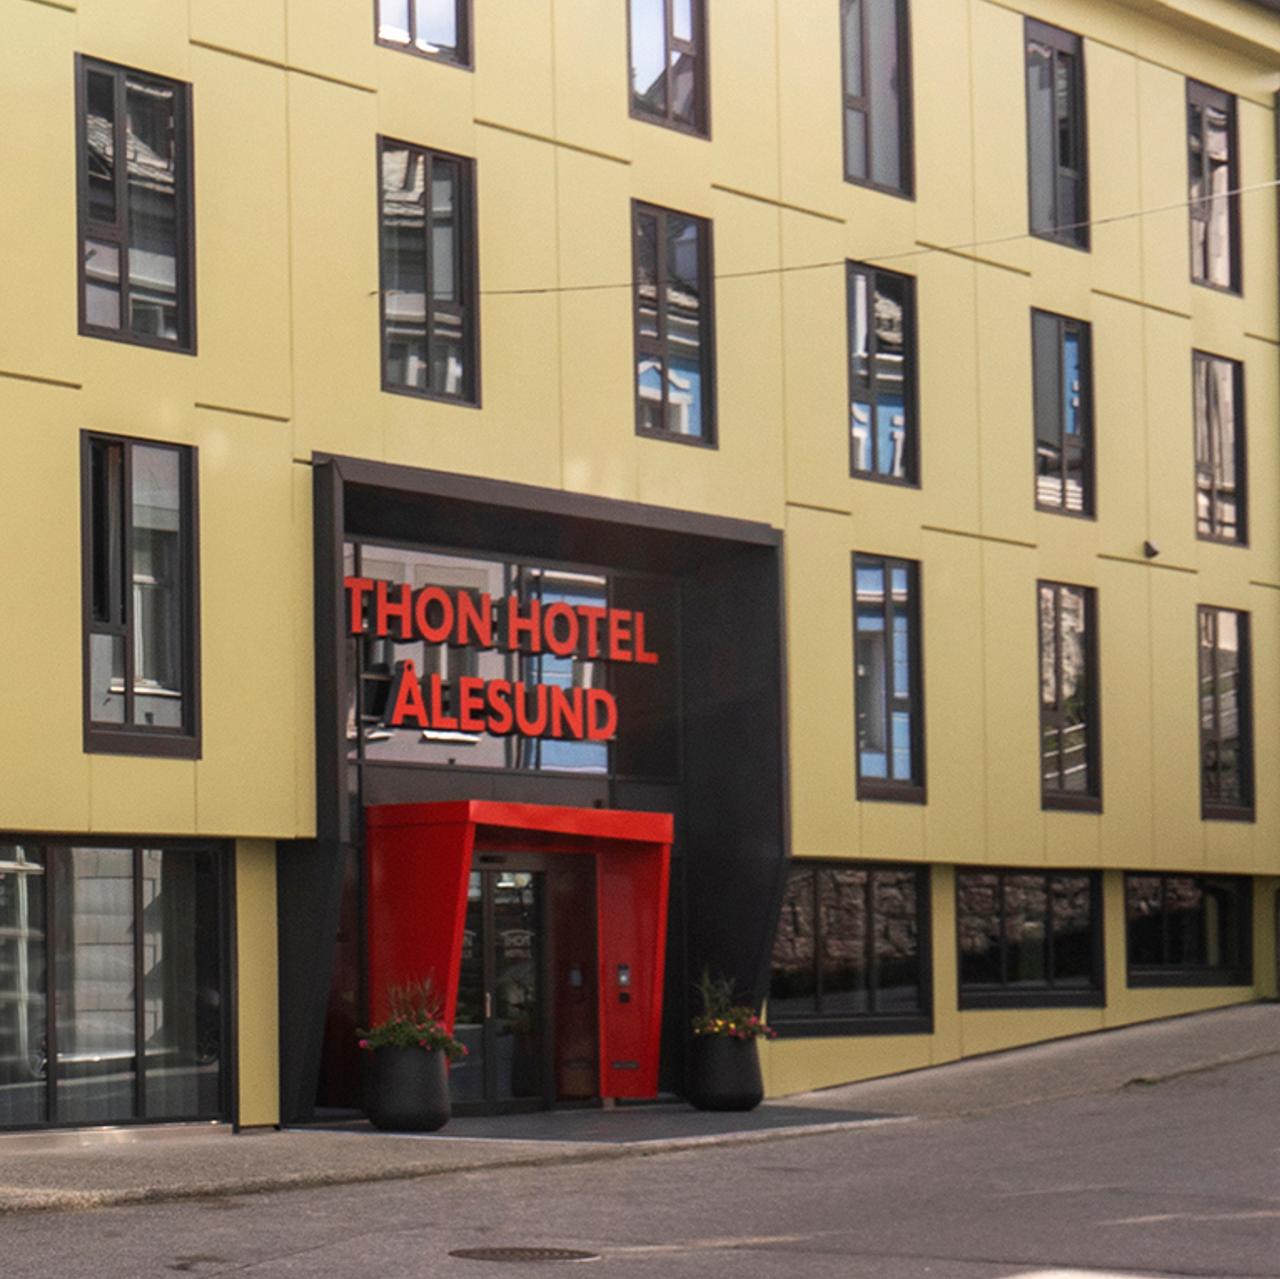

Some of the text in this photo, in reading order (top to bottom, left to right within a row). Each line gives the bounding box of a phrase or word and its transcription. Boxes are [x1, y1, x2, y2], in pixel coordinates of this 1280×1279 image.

[344, 576, 659, 664] THON HOTEL
[391, 658, 619, 741] ÅLESUND
